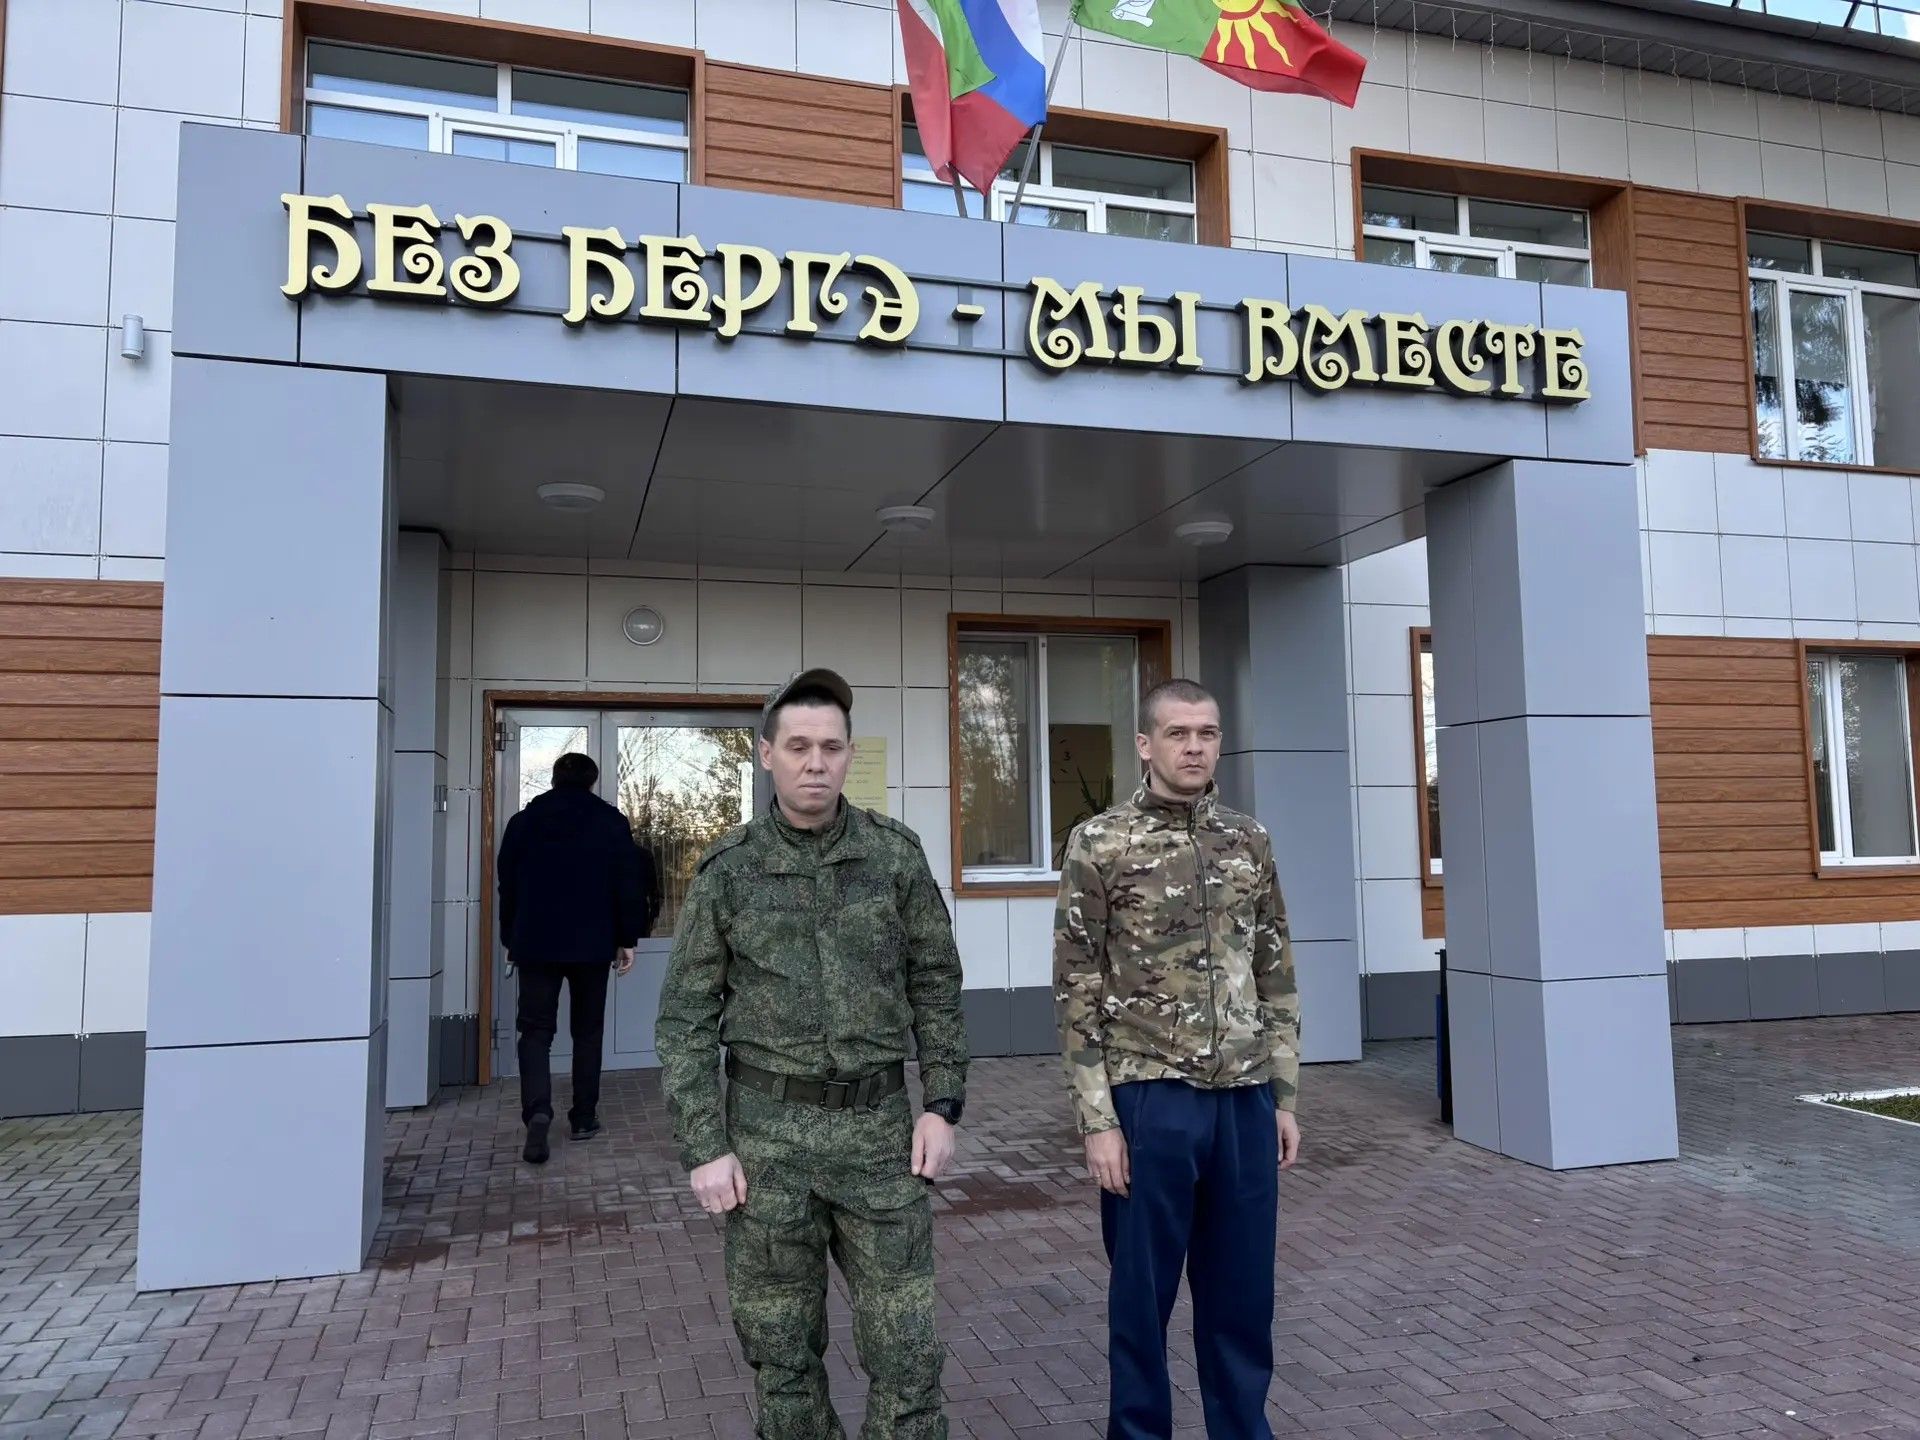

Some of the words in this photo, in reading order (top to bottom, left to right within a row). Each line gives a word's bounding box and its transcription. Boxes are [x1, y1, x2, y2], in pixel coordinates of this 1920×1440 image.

[280, 193, 521, 302] БЕЗ
[562, 226, 920, 342] БЕРГЭ
[954, 303, 985, 318] -
[1028, 277, 1204, 369] МЫ
[1241, 298, 1592, 402] ВМЕСТЕ
